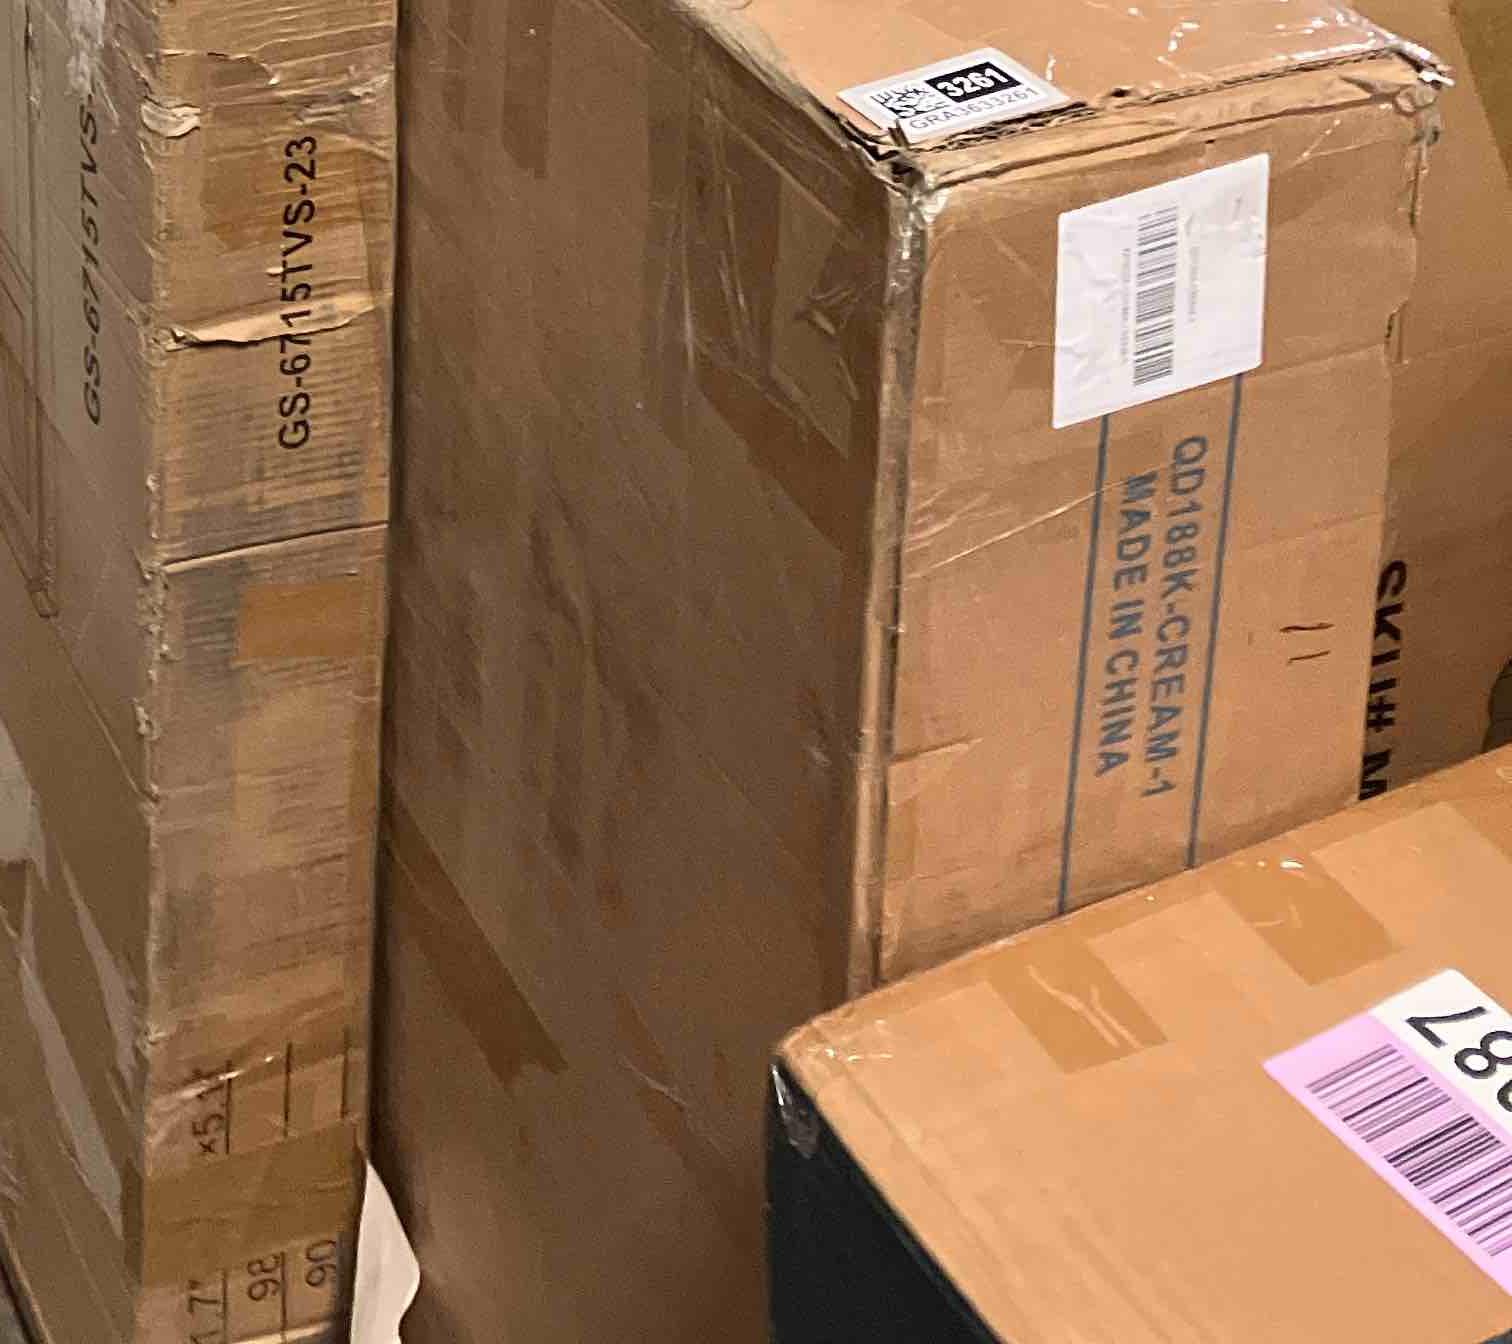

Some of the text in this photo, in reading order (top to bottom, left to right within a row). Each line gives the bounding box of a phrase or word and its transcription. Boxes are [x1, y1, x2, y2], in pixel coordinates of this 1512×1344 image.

[909, 85, 1041, 133] GRA3633261
[935, 66, 1011, 101] 3261
[278, 135, 319, 451] GS-6715TVS-23
[1093, 471, 1160, 778] MADE IN CHINA
[1141, 434, 1210, 799] QD188K-CREAM-1
[1404, 1004, 1512, 1115] 87
